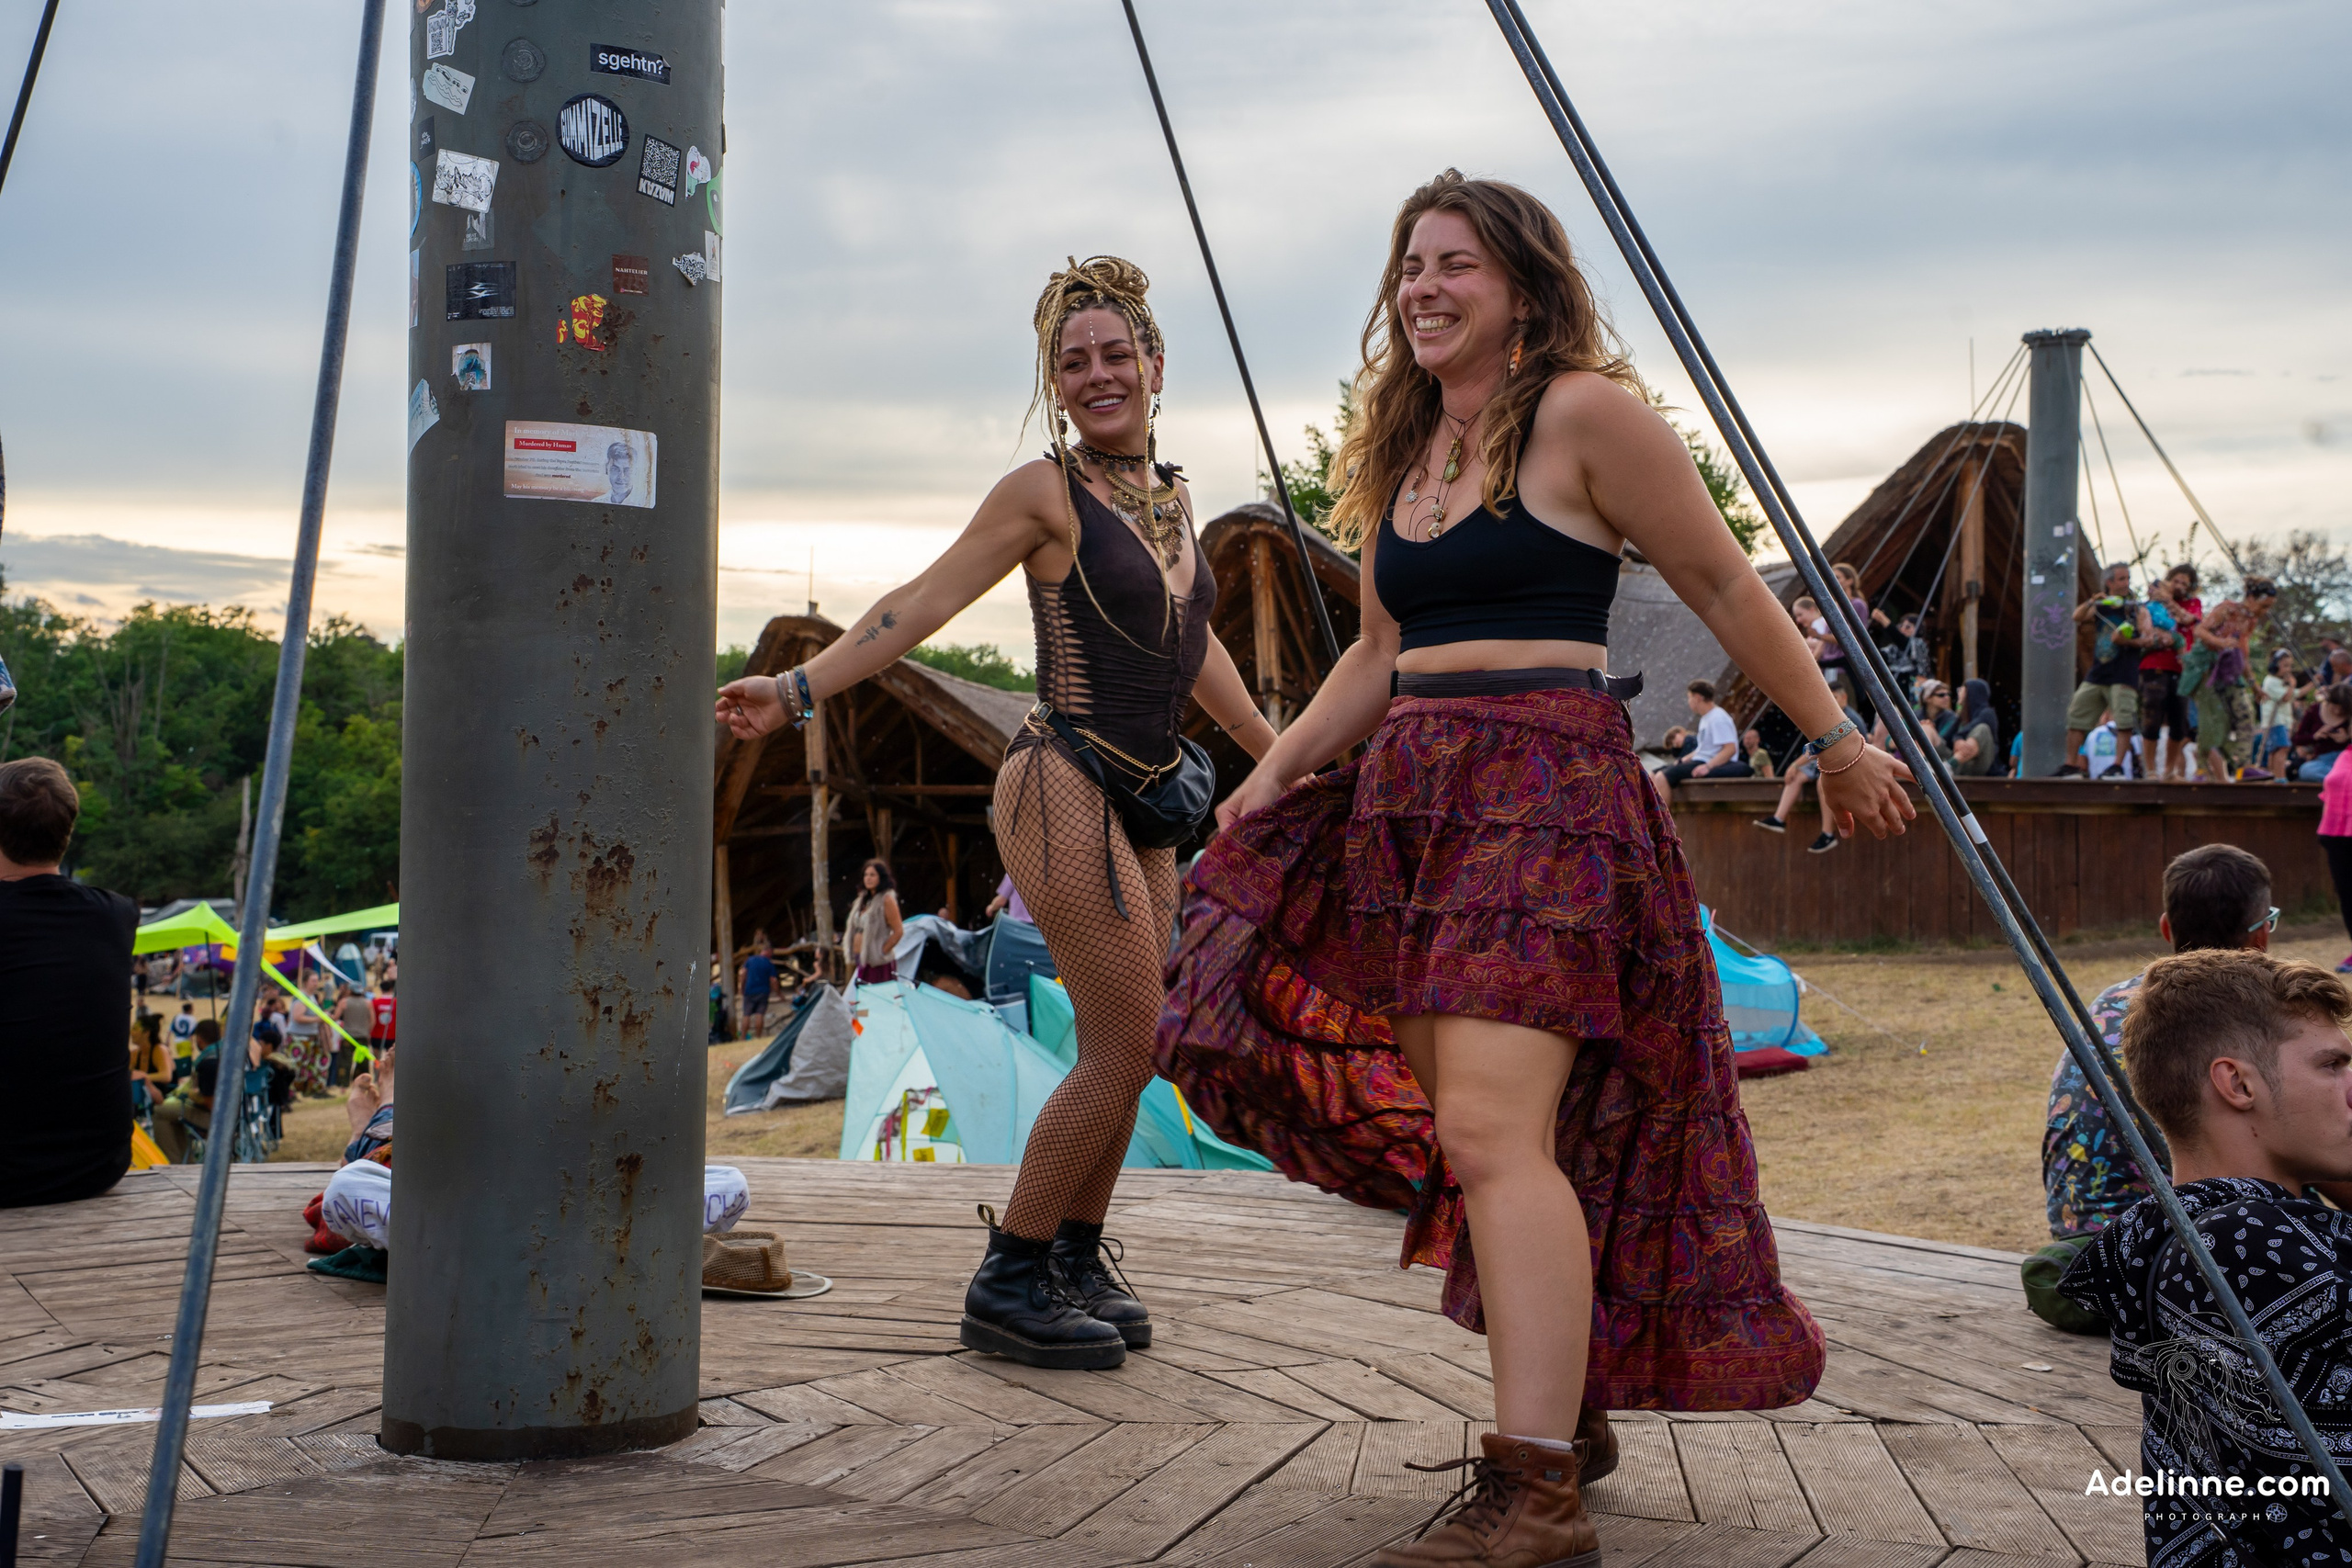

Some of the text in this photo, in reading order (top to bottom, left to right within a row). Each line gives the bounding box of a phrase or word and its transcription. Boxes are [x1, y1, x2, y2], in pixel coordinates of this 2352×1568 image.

[598, 52, 663, 74] sgehtn?
[560, 97, 624, 161] GUMMIZELLE
[2288, 1372, 2301, 1389] STRE
